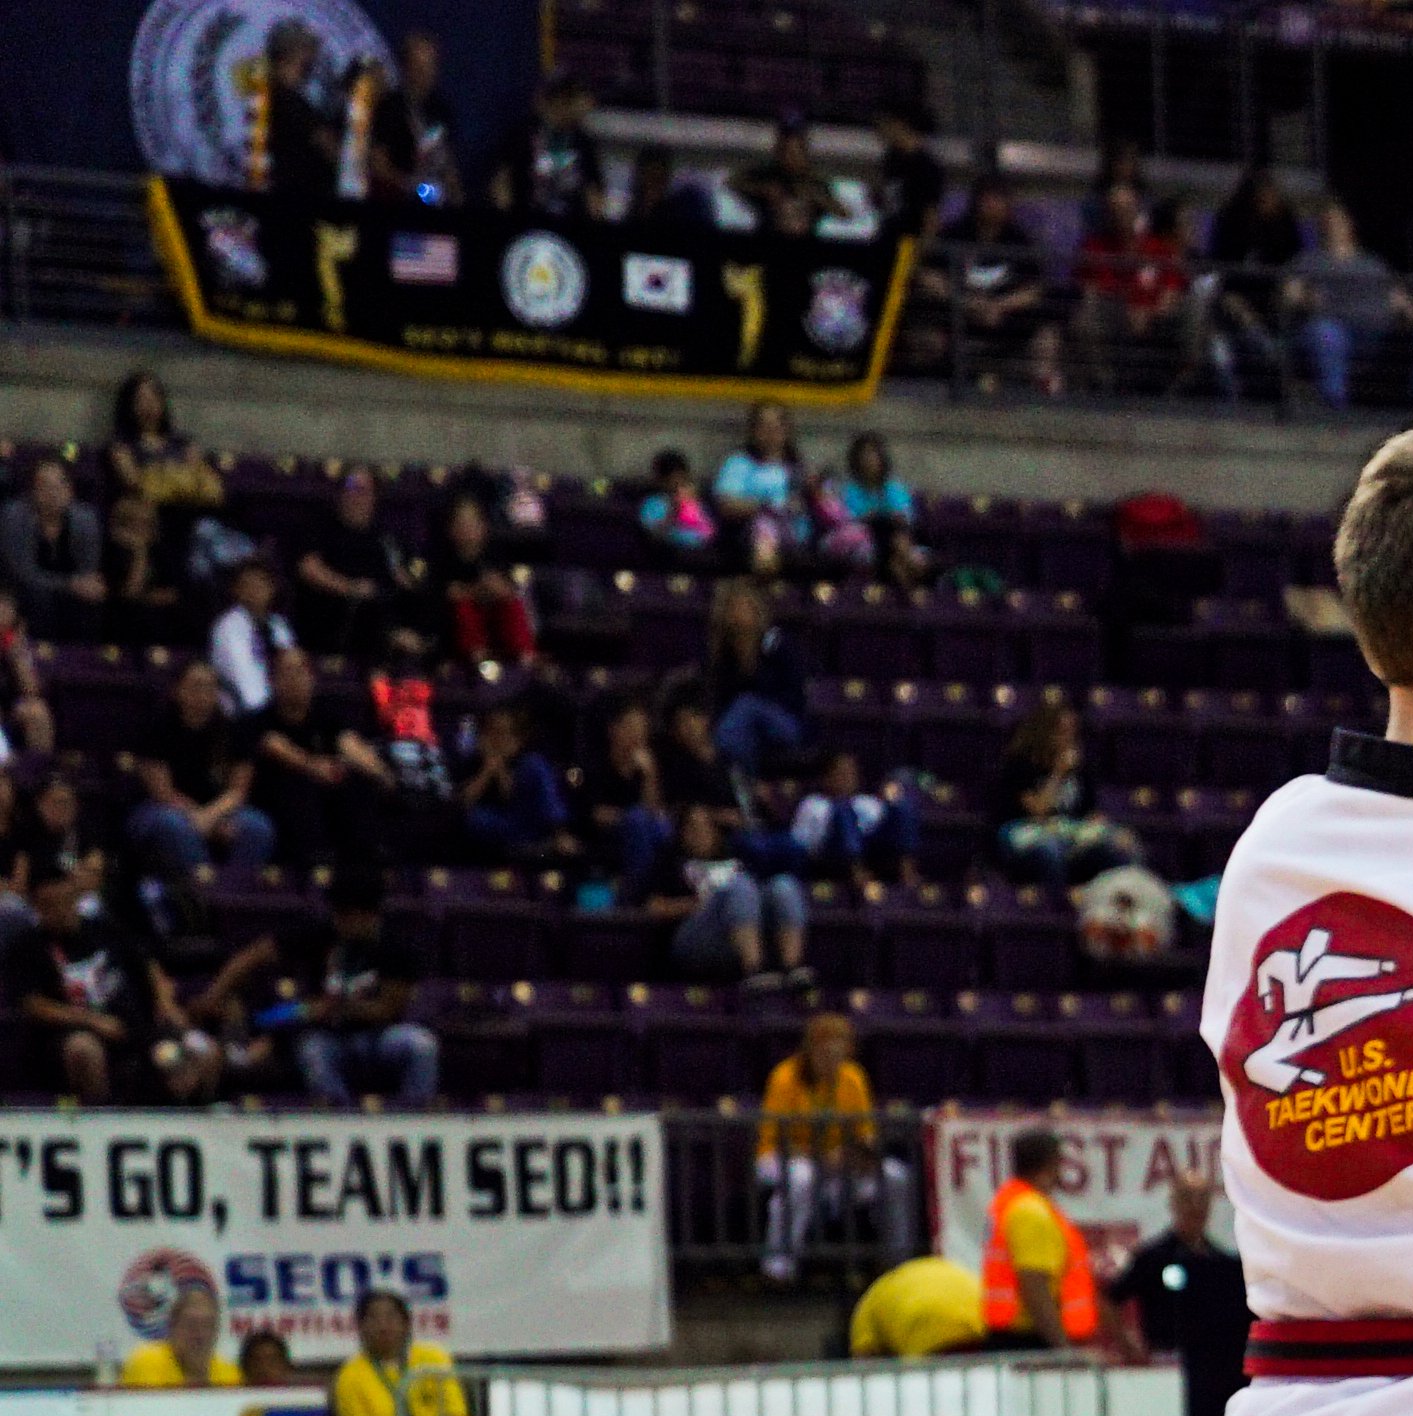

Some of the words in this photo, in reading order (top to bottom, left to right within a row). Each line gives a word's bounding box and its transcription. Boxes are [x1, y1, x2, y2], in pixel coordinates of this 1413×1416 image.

[1338, 1038, 1396, 1080] U.S.
[0, 1135, 84, 1222] 'S
[106, 1135, 228, 1238] GO,
[247, 1135, 445, 1222] TEAM
[465, 1134, 646, 1221] SEO!!
[951, 1130, 1128, 1196] FIST
[225, 1253, 449, 1305] SEO'S
